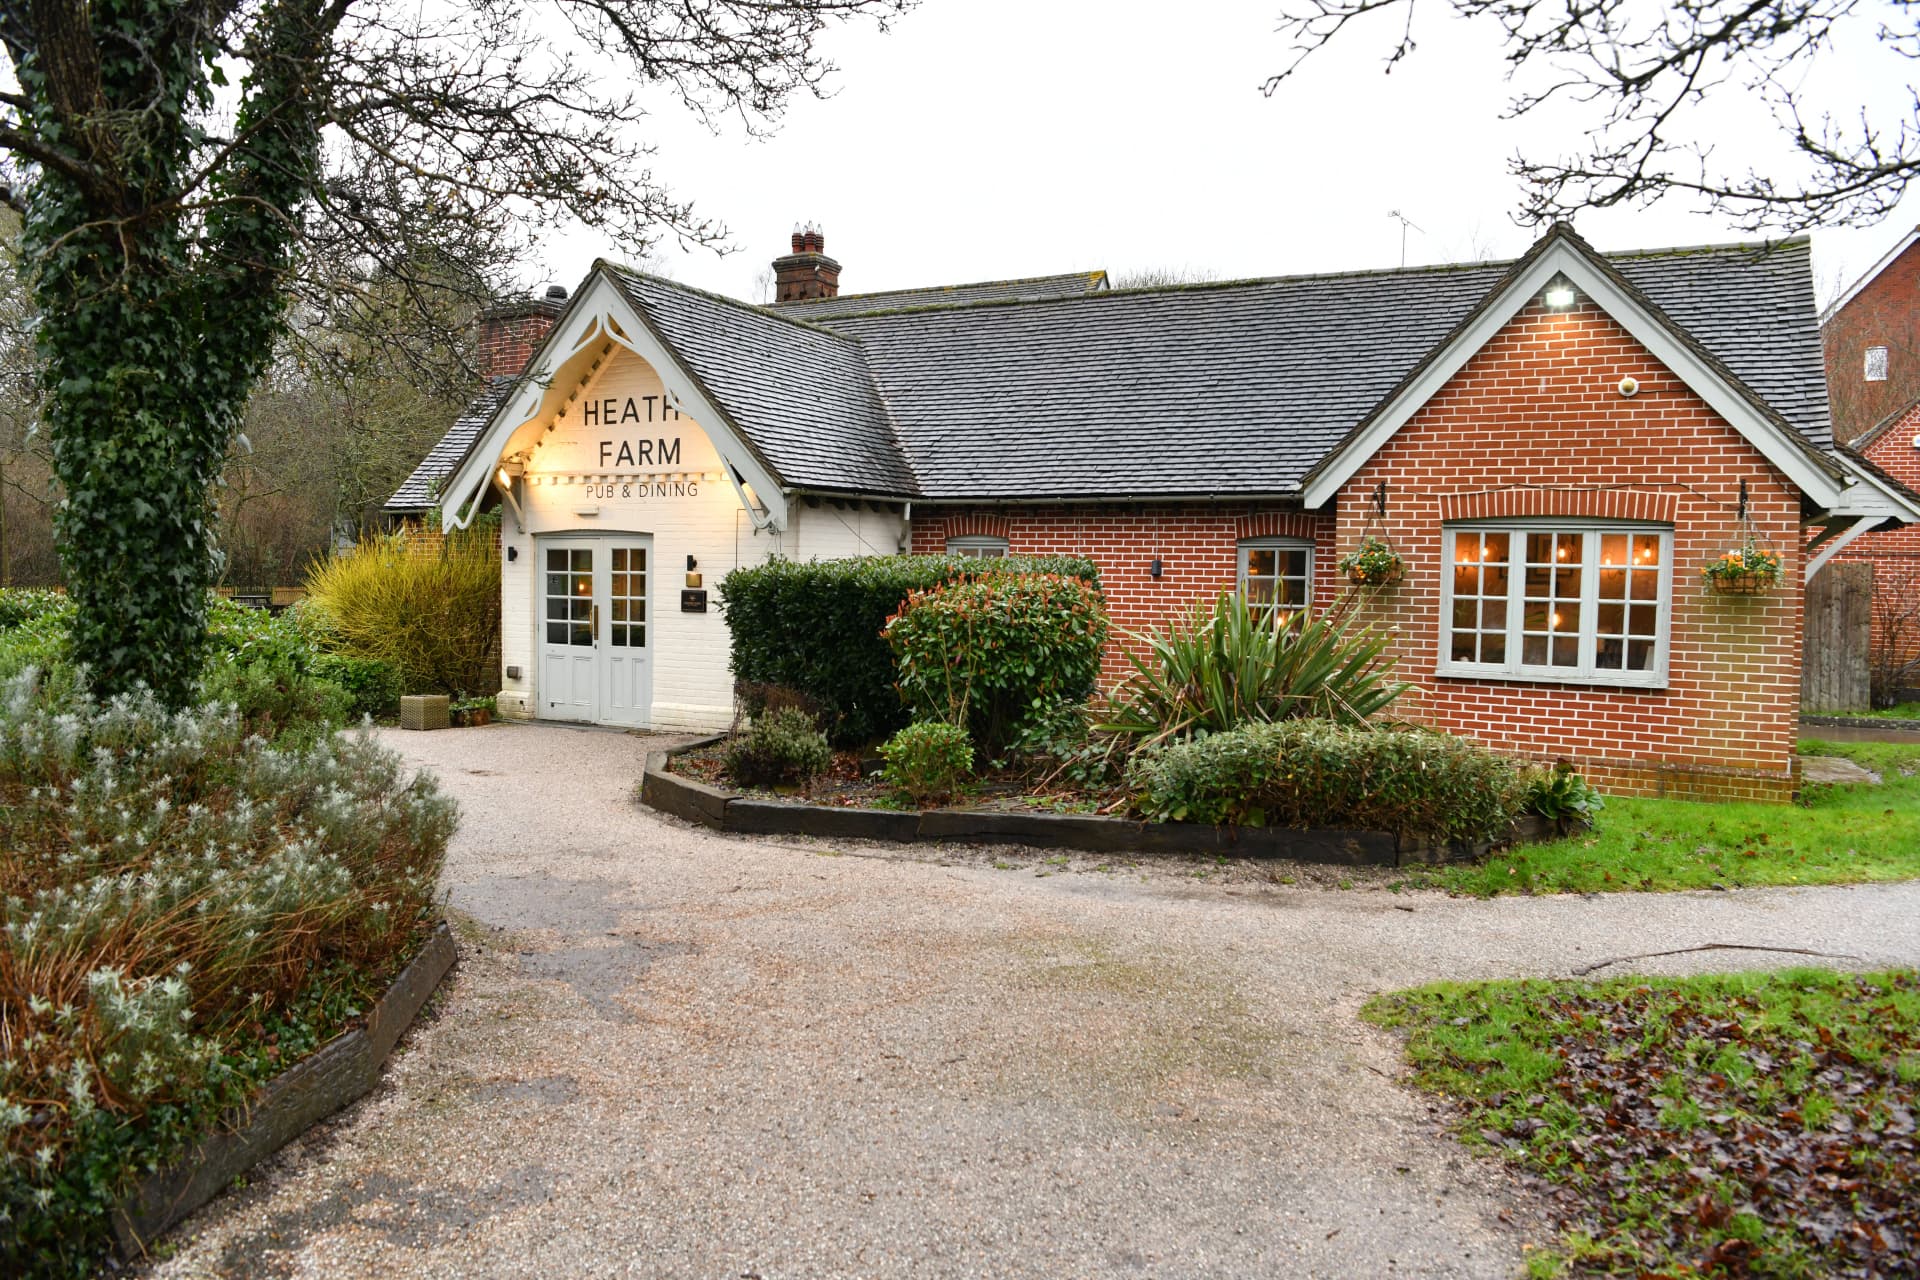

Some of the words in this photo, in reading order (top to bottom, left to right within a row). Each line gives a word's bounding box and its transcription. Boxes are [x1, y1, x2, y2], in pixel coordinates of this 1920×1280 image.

[584, 395, 679, 426] HEATH
[600, 438, 680, 467] FARM
[586, 485, 614, 498] PUB
[622, 484, 631, 498] &
[639, 483, 698, 497] DINING
